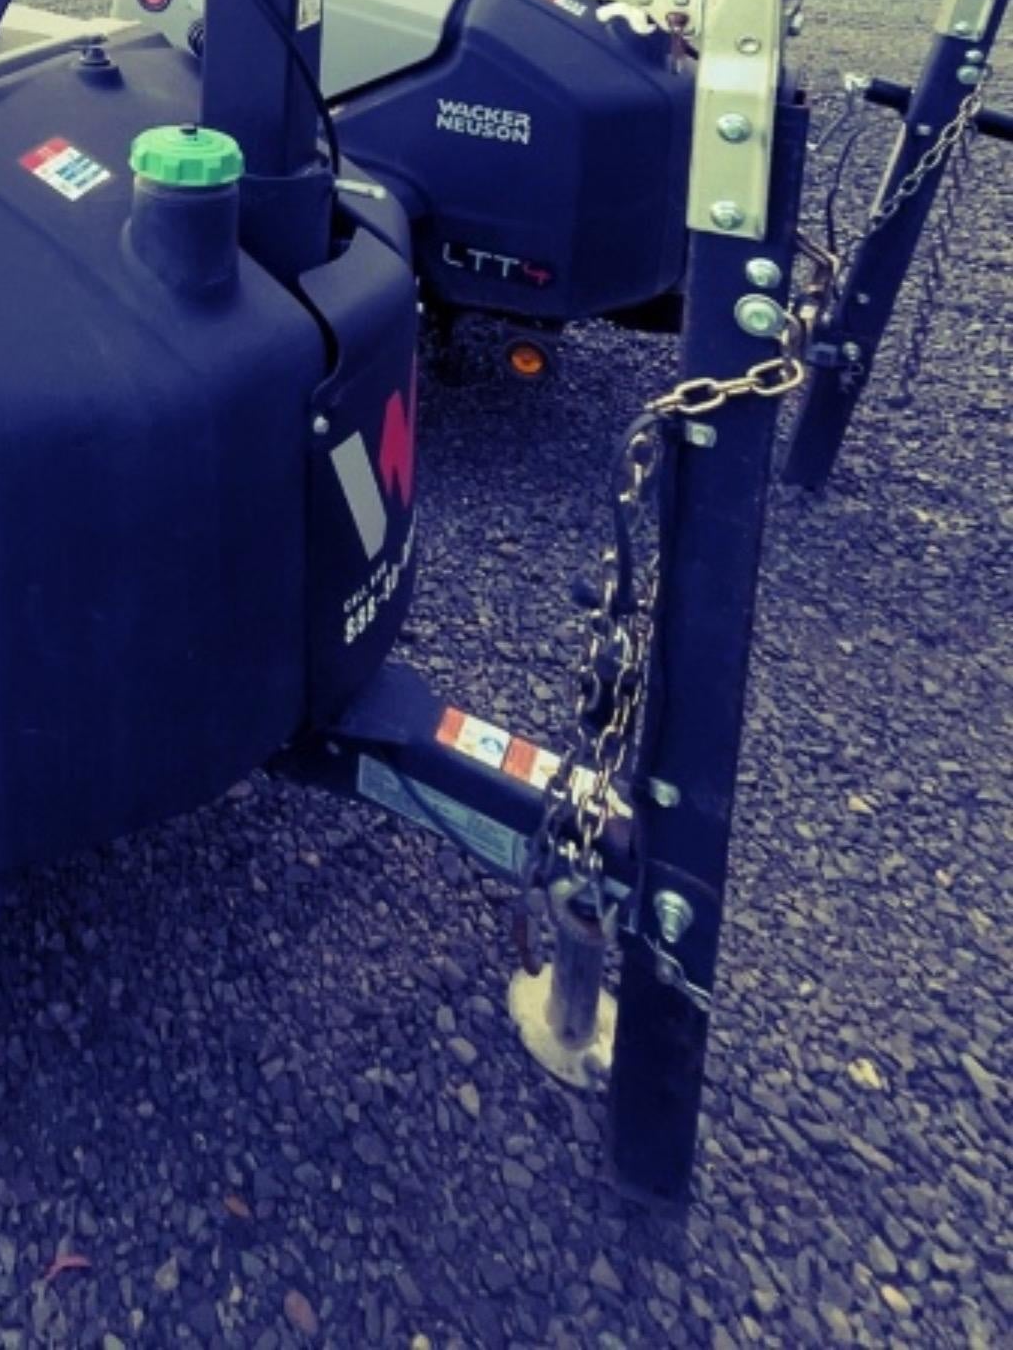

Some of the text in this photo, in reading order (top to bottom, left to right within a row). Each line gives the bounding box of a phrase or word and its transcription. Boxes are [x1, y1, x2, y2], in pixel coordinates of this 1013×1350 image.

[436, 113, 531, 144] NEUSON
[437, 98, 531, 128] WACKER
[441, 242, 552, 285] LTT4
